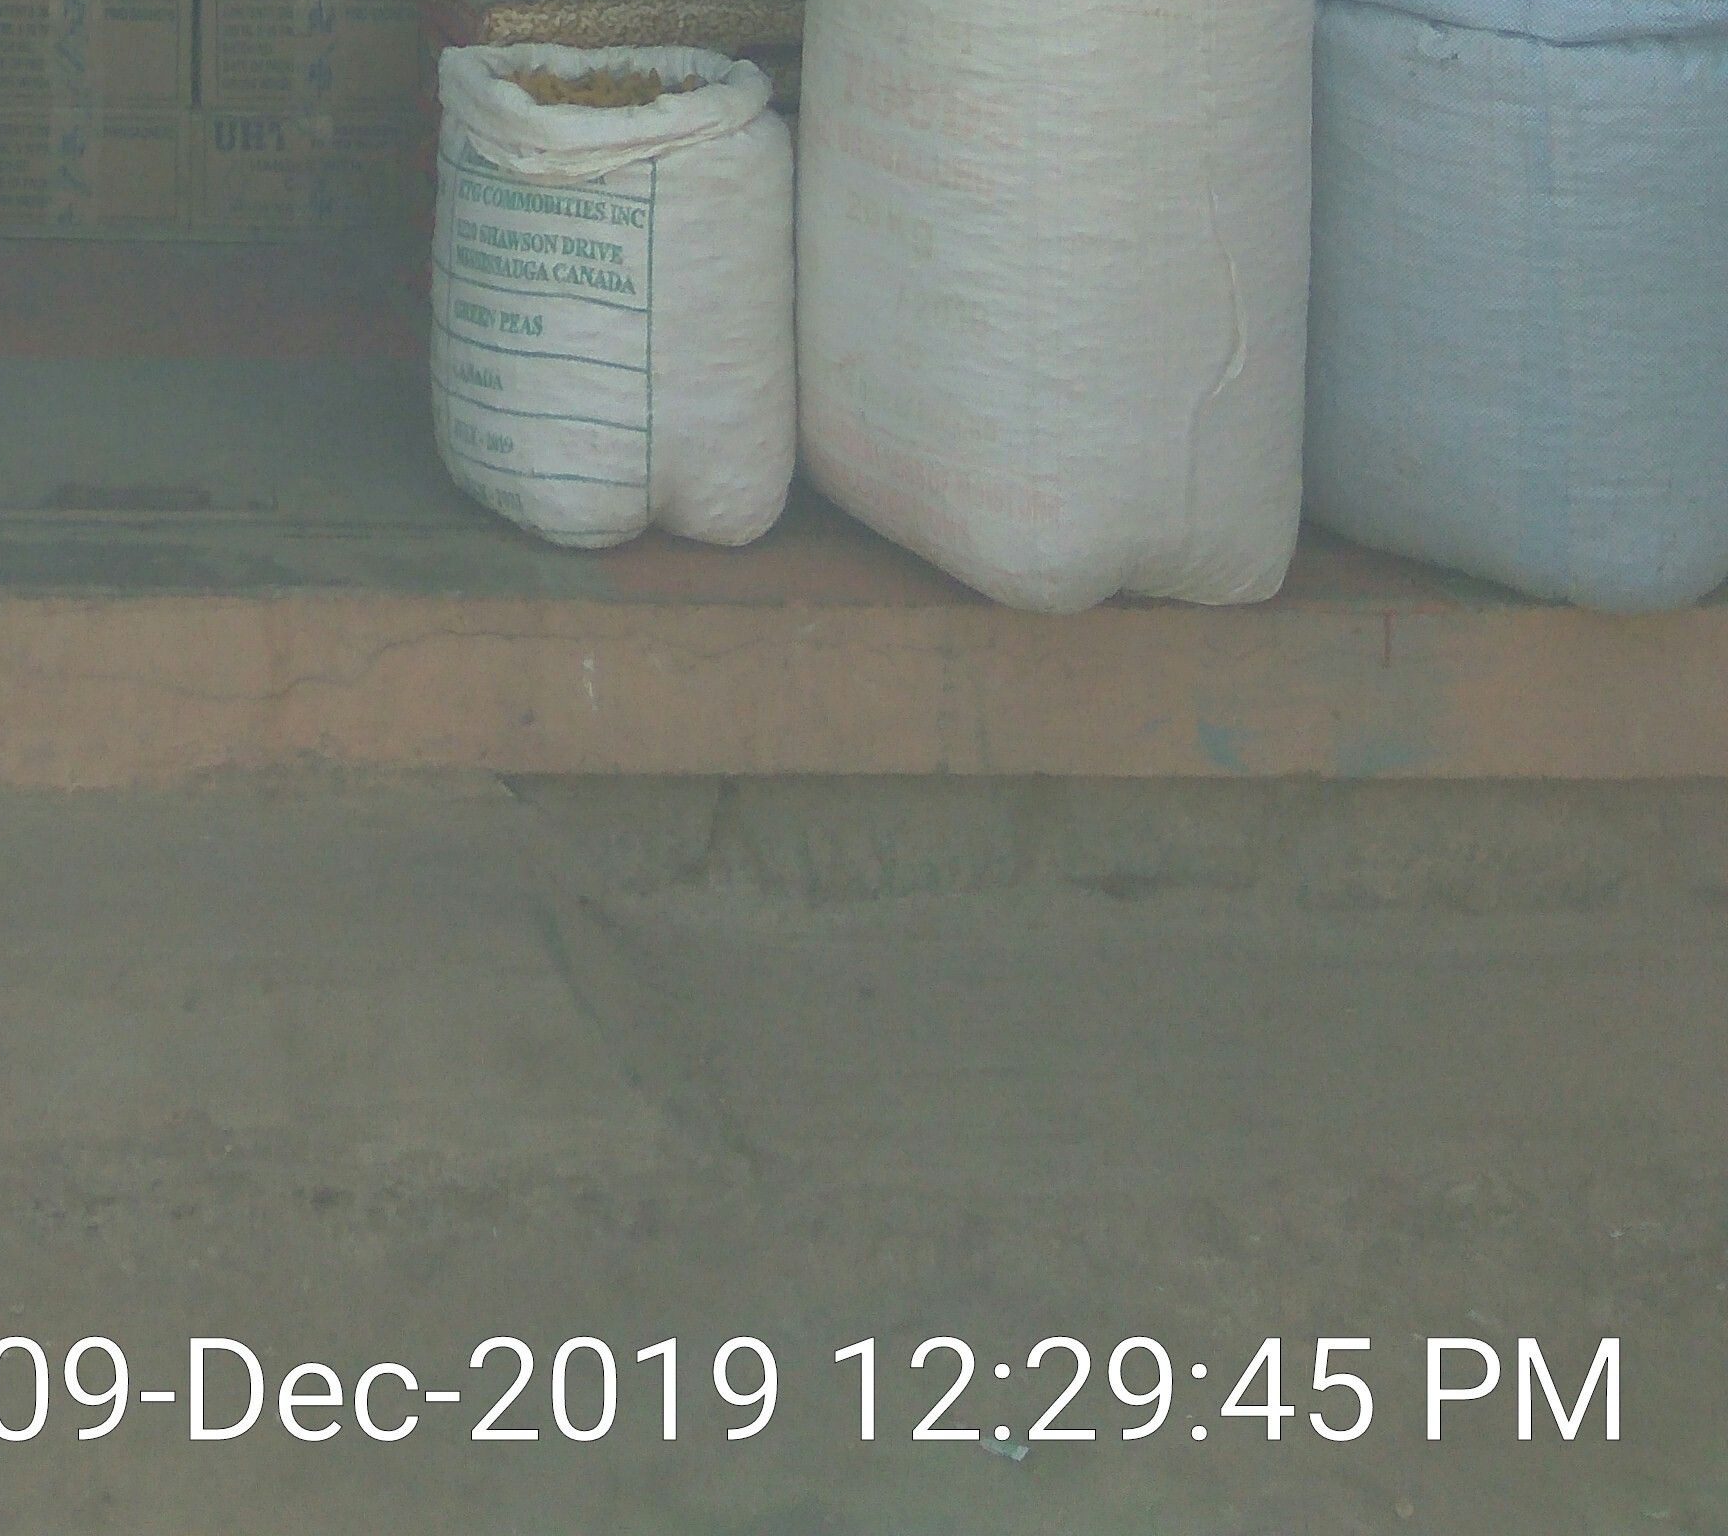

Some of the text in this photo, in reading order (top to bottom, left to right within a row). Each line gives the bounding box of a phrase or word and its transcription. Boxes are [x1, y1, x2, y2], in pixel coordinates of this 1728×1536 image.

[610, 203, 647, 229] INC
[561, 234, 624, 265] DRIVE
[552, 262, 637, 296] CANADA
[499, 310, 544, 337] PEAS
